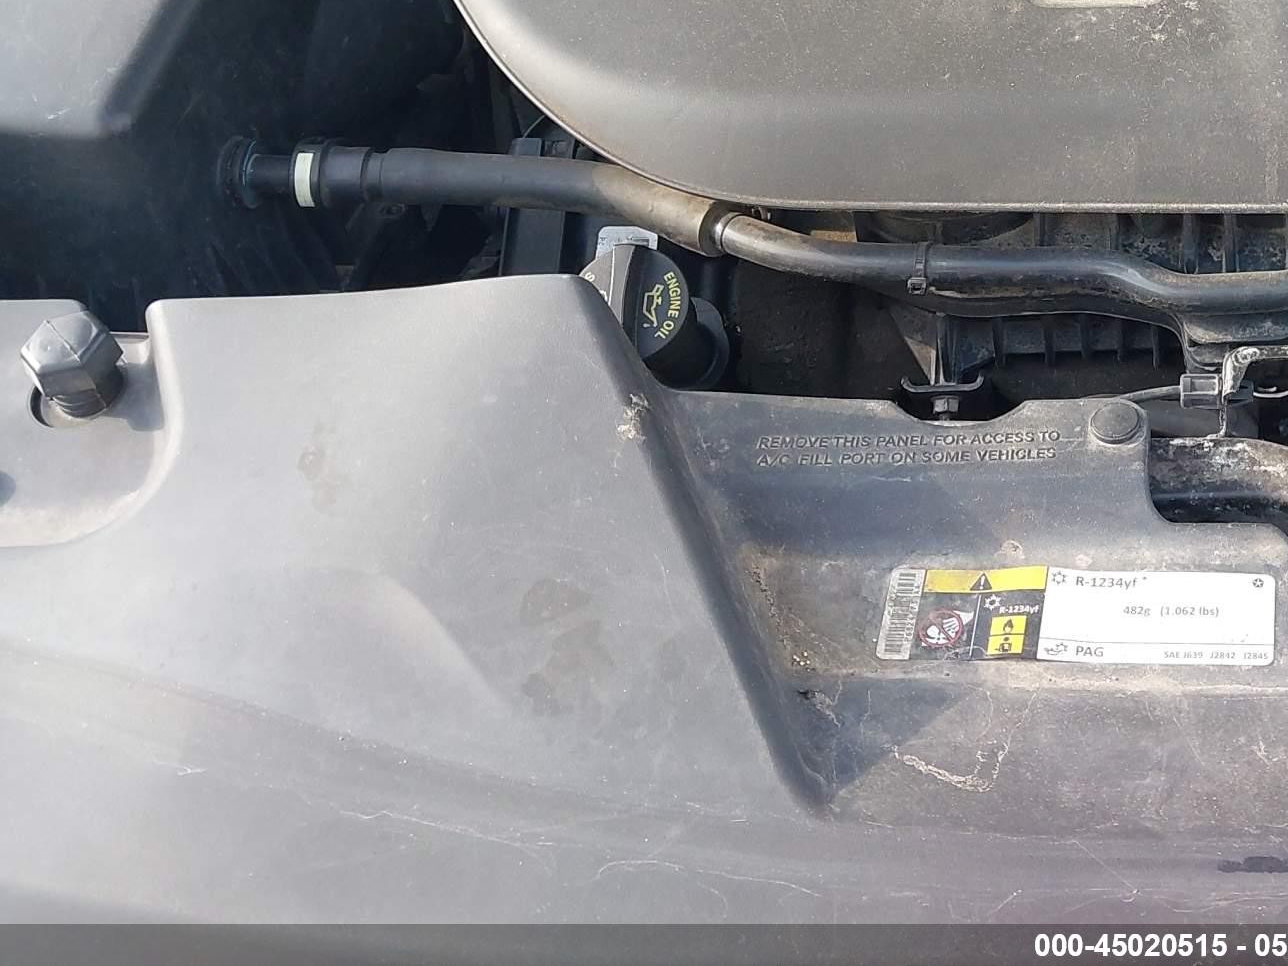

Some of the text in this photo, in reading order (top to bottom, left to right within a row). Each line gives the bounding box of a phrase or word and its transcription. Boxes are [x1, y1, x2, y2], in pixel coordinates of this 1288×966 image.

[654, 271, 681, 339] ENGINE OIL
[757, 430, 1060, 450] REMOVE THIS PANEL FOR ACCESS TO
[757, 447, 1057, 467] A/C FILL PORT ON SOME VEHICLES
[1123, 605, 1220, 618] 482g (1.062 lbs)
[1075, 646, 1105, 658] PAG
[1163, 651, 1181, 659] SAE
[1209, 651, 1237, 659] J2842
